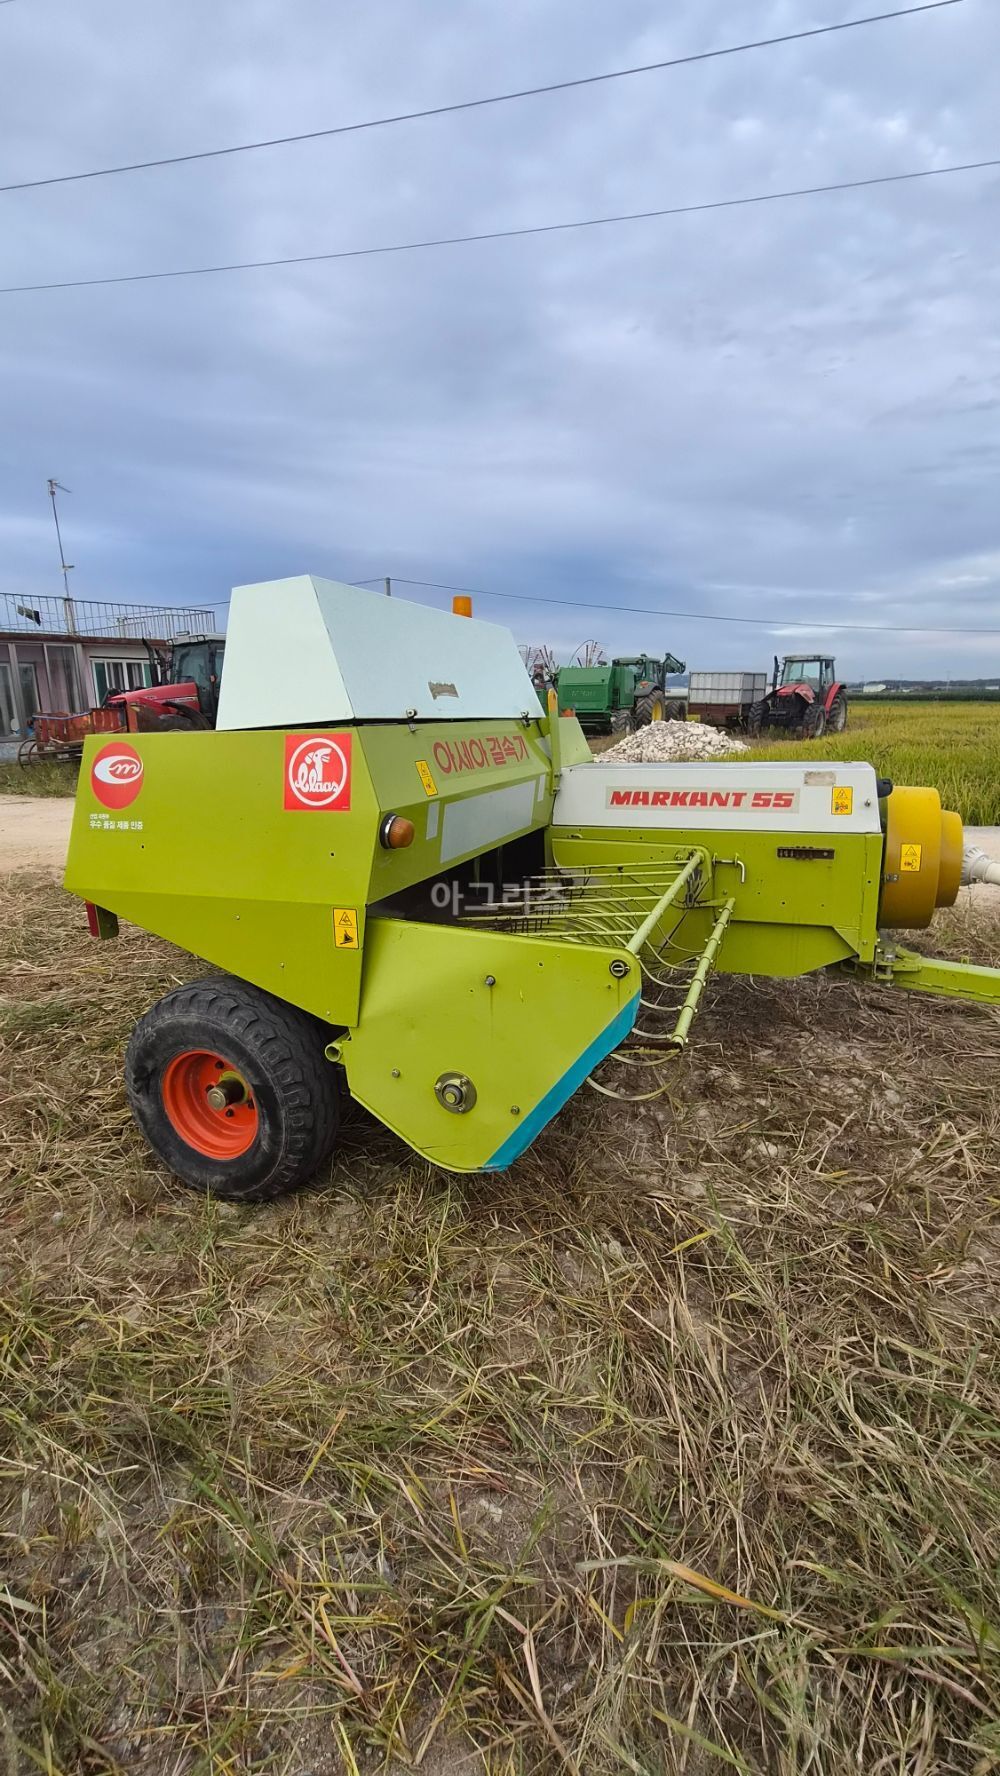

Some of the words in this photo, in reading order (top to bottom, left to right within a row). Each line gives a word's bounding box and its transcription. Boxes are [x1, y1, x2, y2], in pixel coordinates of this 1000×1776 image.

[433, 738, 490, 774] 아세아
[610, 791, 747, 807] MARKANT
[751, 792, 795, 808] 55
